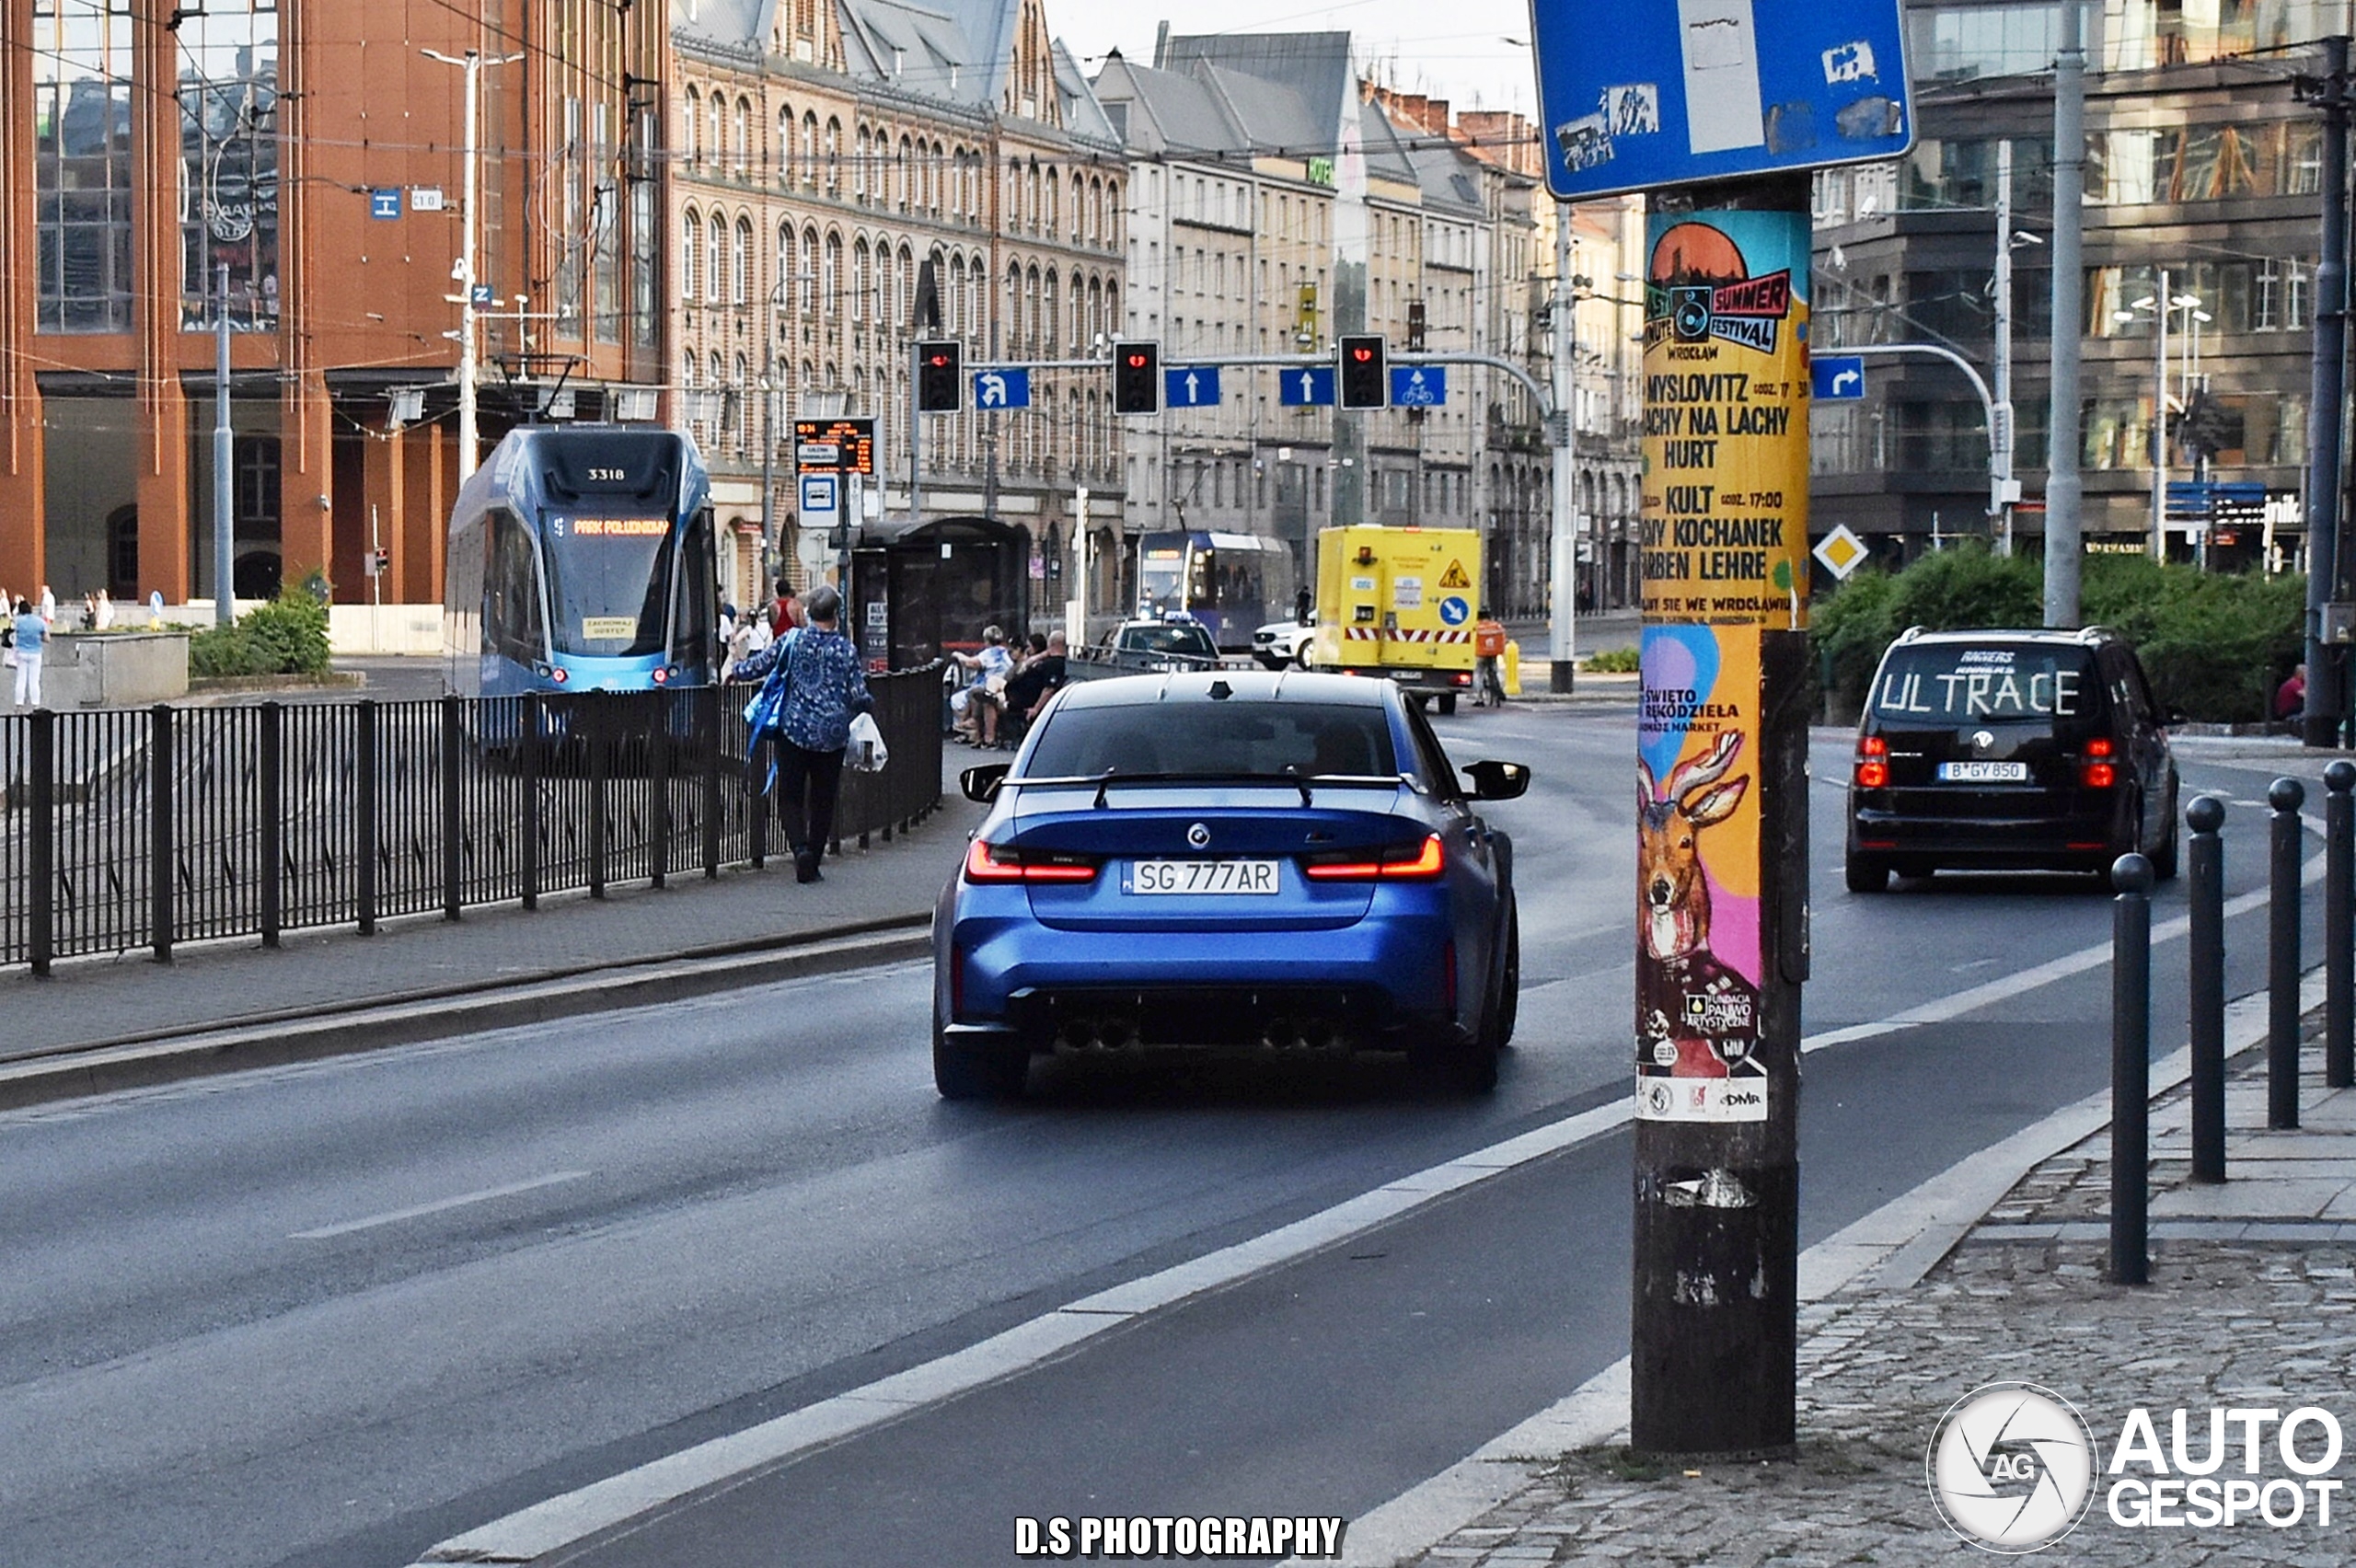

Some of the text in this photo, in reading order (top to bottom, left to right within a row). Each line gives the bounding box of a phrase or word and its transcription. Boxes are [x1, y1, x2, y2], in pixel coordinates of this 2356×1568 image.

[1715, 277, 1784, 311] SUMMER
[1712, 320, 1772, 347] FESTIVAL
[1667, 346, 1718, 361] WROCŁAW
[1647, 373, 1748, 403] MYSLOVITZ
[1689, 407, 1718, 435] NA
[1727, 407, 1789, 436] LACHY
[1664, 440, 1718, 468] HURT
[588, 468, 625, 480] 3318
[1666, 486, 1715, 514] KULT
[1721, 494, 1746, 506] GODZ.
[1750, 491, 1783, 508] 17:00
[573, 520, 603, 535] PARK
[1673, 518, 1783, 547] KOCHANEK
[1700, 551, 1767, 580] LEHRE
[1686, 597, 1707, 611] WE
[1672, 722, 1721, 732] MARKET
[1952, 764, 2019, 778] B GY 850
[1140, 864, 1271, 890] SG 777AR
[1687, 1016, 1750, 1028] ARTYSTYCZNE
[1708, 1004, 1751, 1016] PALIWO
